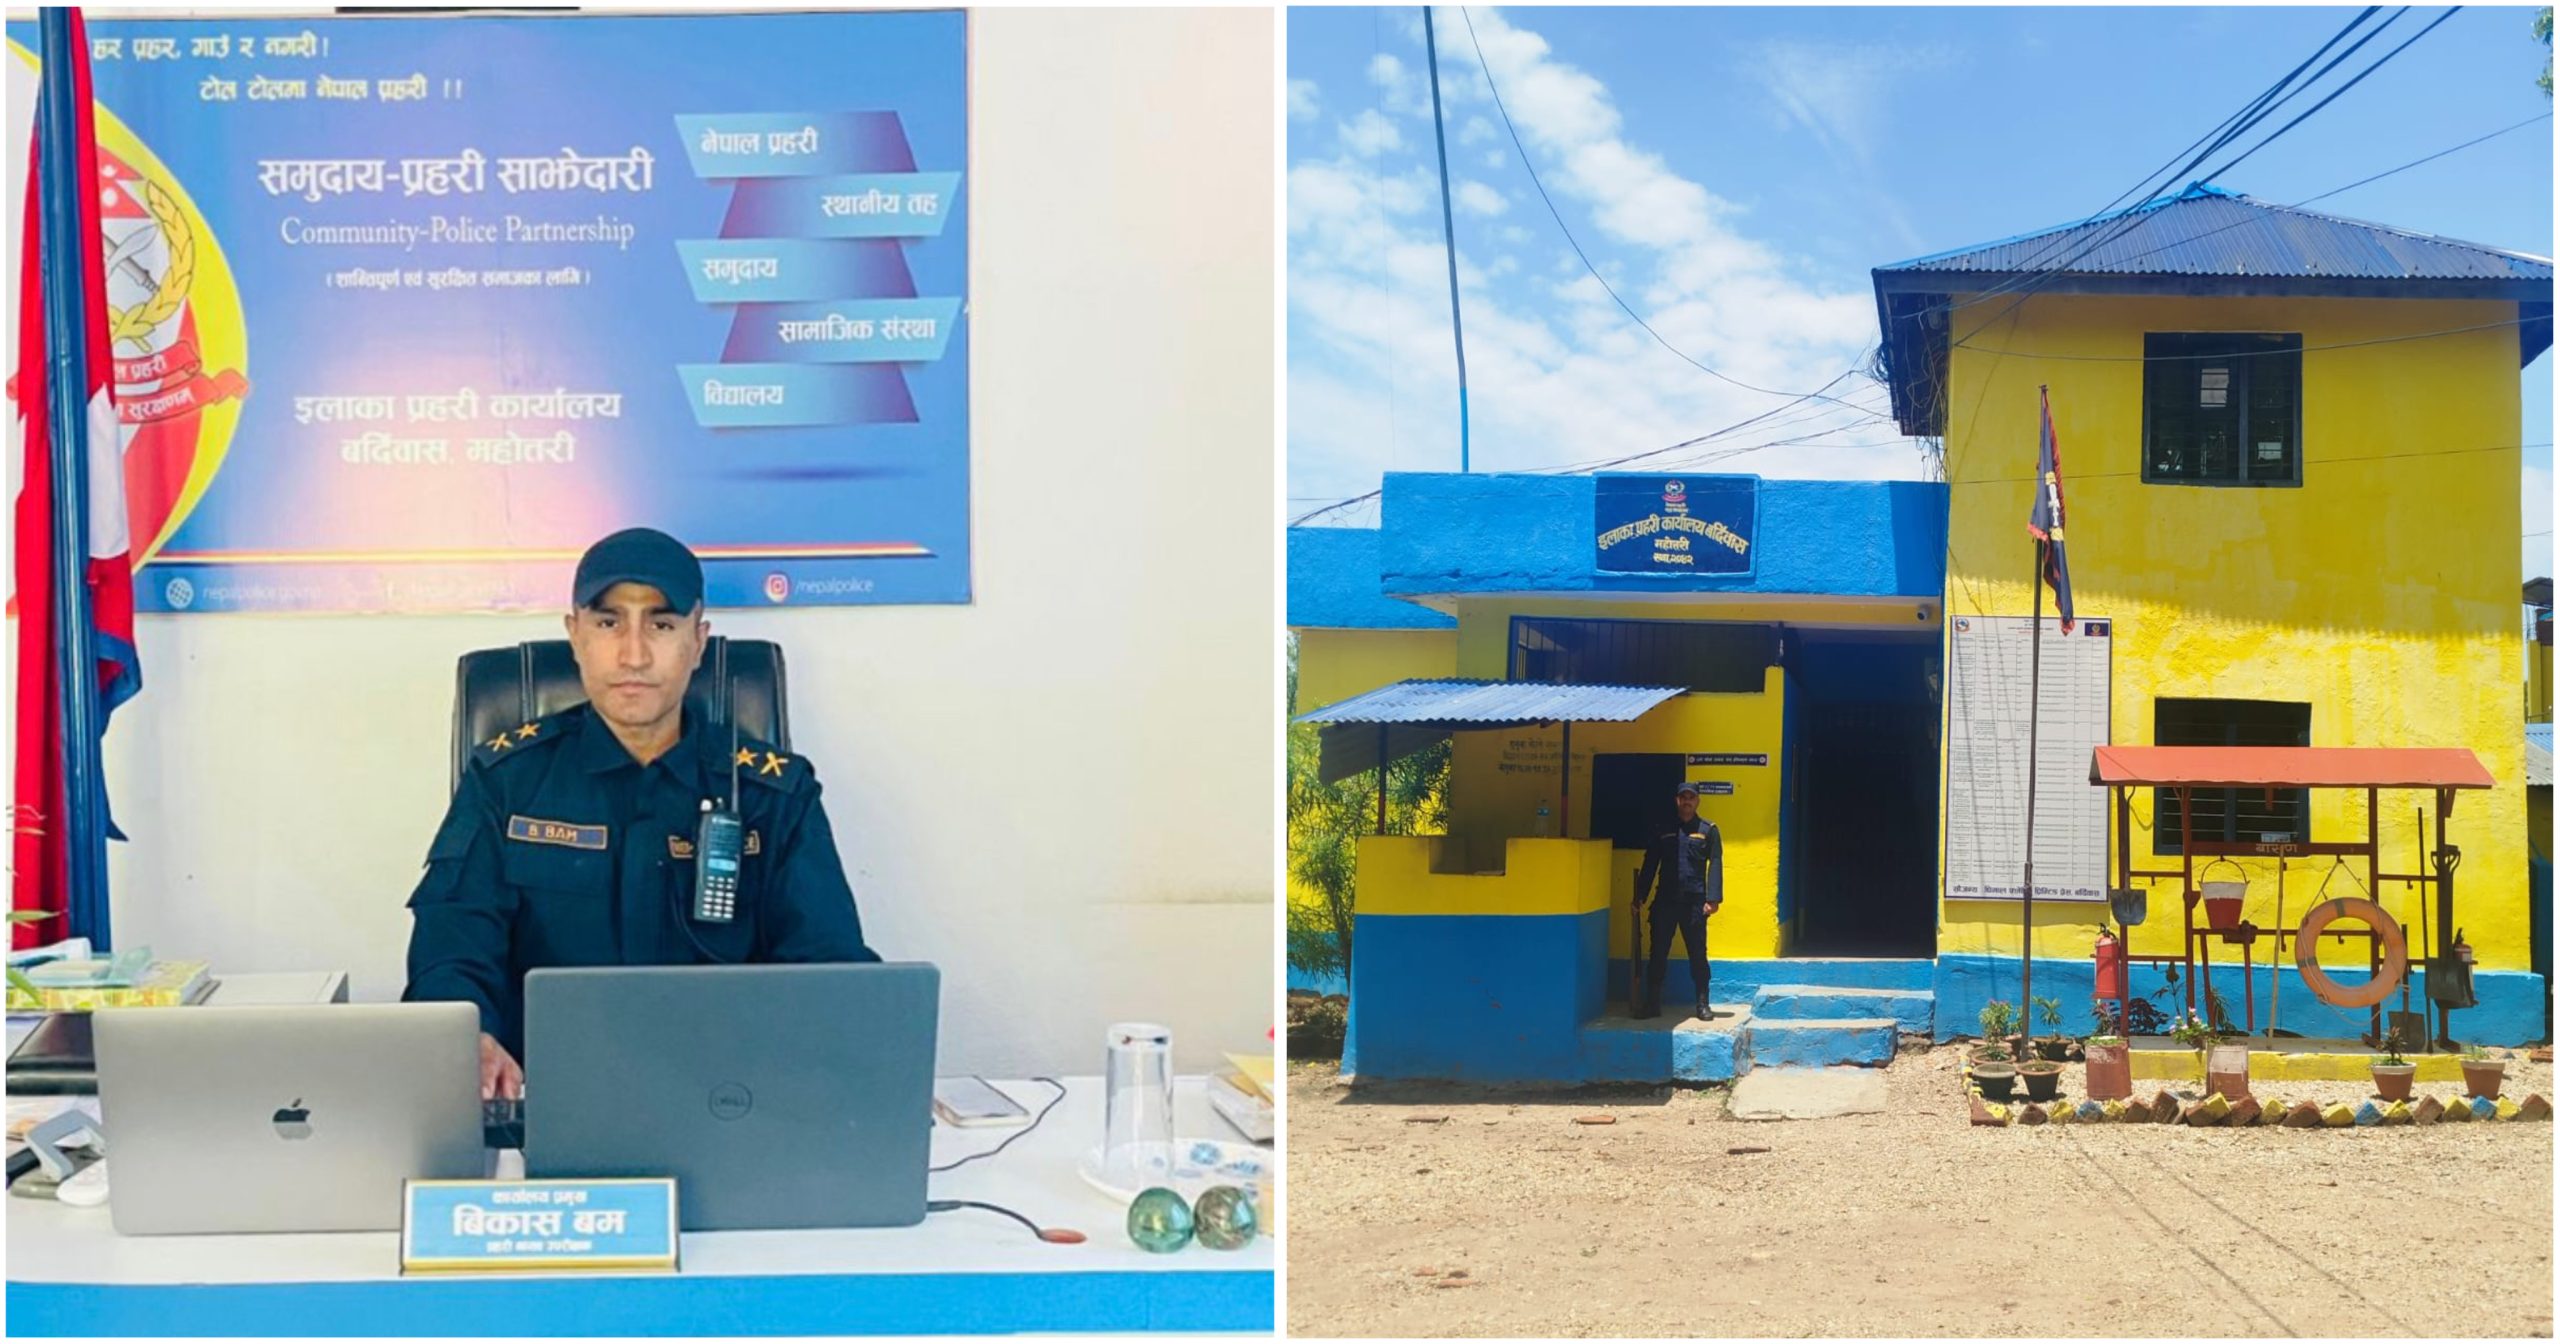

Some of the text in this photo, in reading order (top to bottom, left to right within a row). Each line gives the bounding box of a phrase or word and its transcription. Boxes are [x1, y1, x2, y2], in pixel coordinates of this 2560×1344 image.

[93, 38, 122, 61] हर
[239, 37, 254, 58] र
[200, 74, 237, 100] टोल
[247, 74, 307, 100] टोलमा
[316, 74, 368, 99] नेपाल
[378, 72, 428, 102] प्रहरी
[701, 126, 819, 156] नेपाल प्रहरी
[258, 146, 656, 203] समुदाय-प्रहरी साझेदारी
[821, 188, 939, 217] स्थानीय तह
[280, 214, 636, 252] Community-Police Partnership
[702, 257, 779, 285] समुदाय
[778, 313, 937, 343] सामाजिक संस्था
[294, 386, 623, 424] इलाका प्रहरी कार्यालय
[703, 378, 785, 407] विद्यालय
